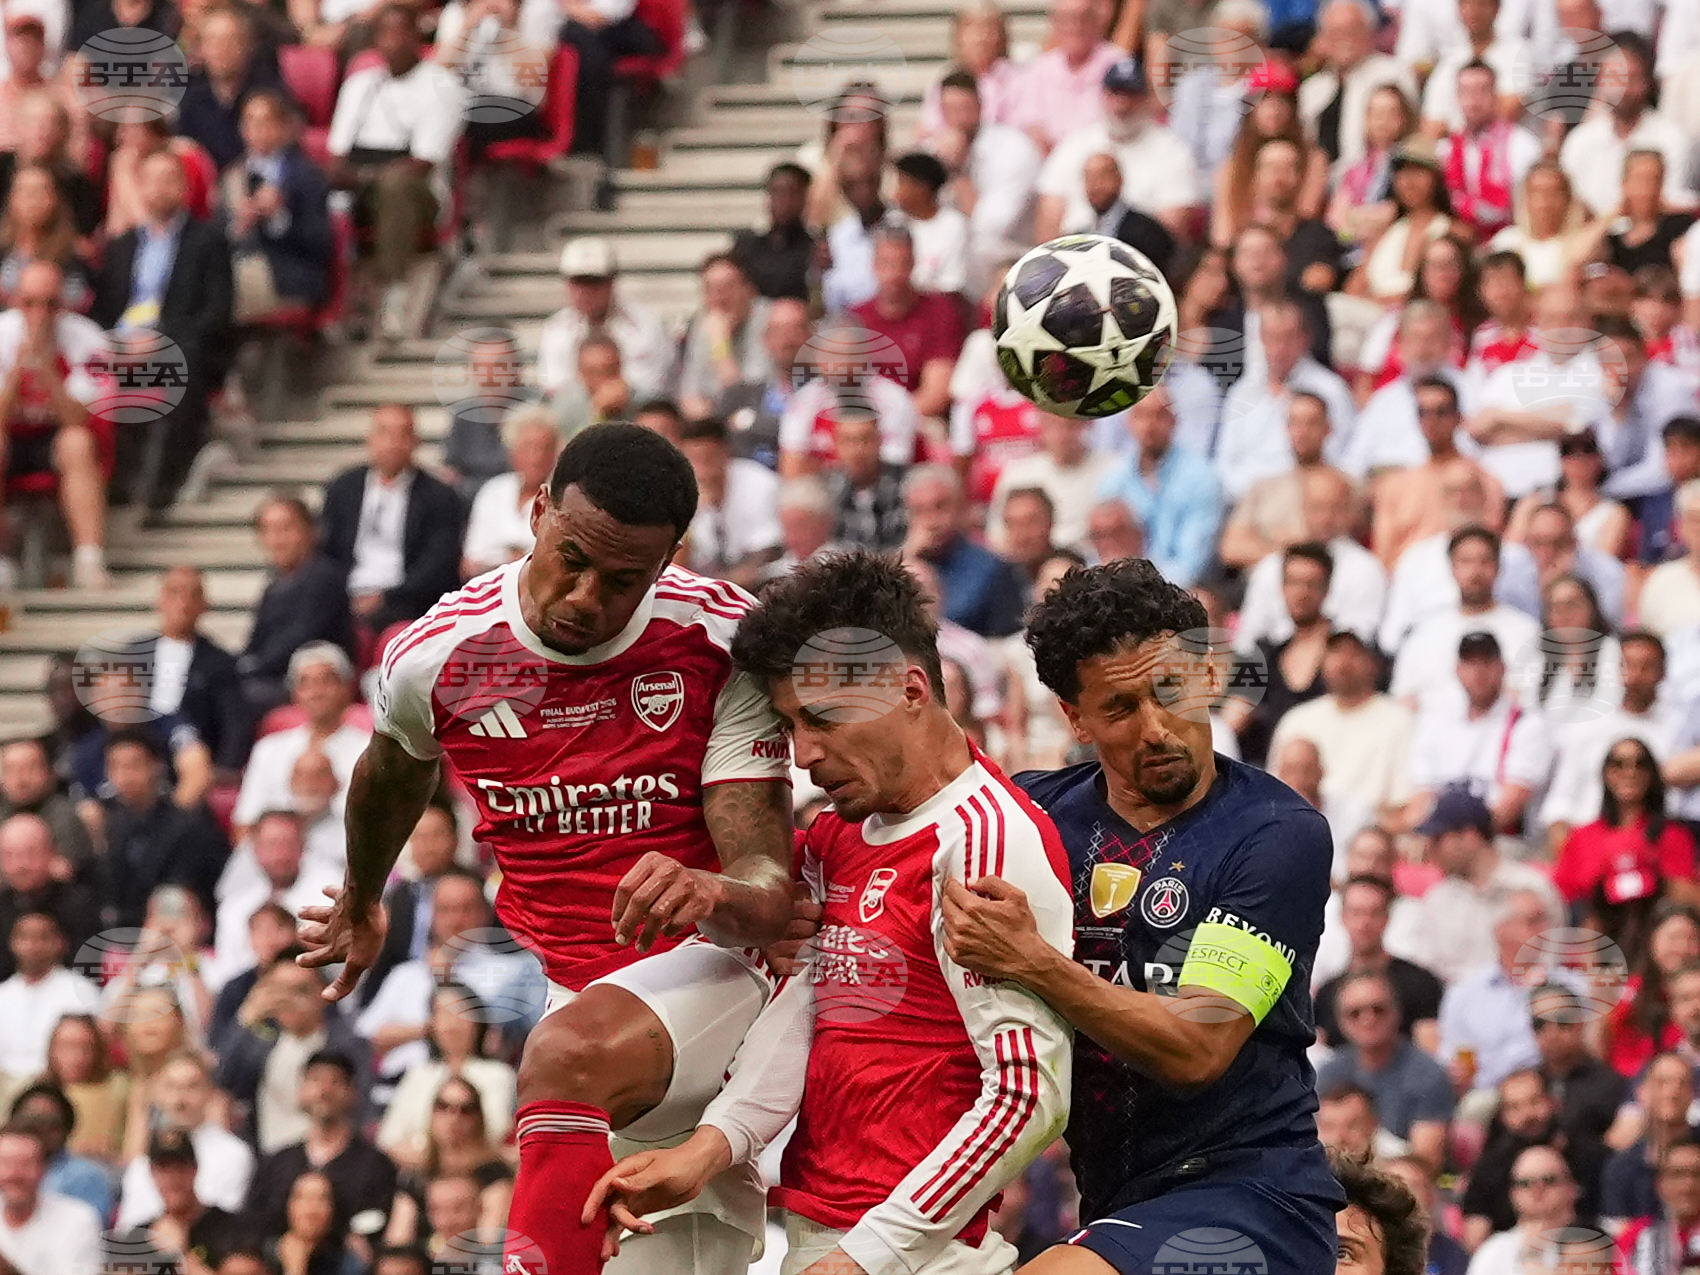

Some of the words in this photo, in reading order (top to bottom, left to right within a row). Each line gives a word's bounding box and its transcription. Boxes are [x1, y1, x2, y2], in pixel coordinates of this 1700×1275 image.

[638, 680, 676, 691] Arsenal
[477, 773, 680, 816] Emirates
[557, 801, 652, 835] BETTER
[1153, 879, 1184, 895] PARIS
